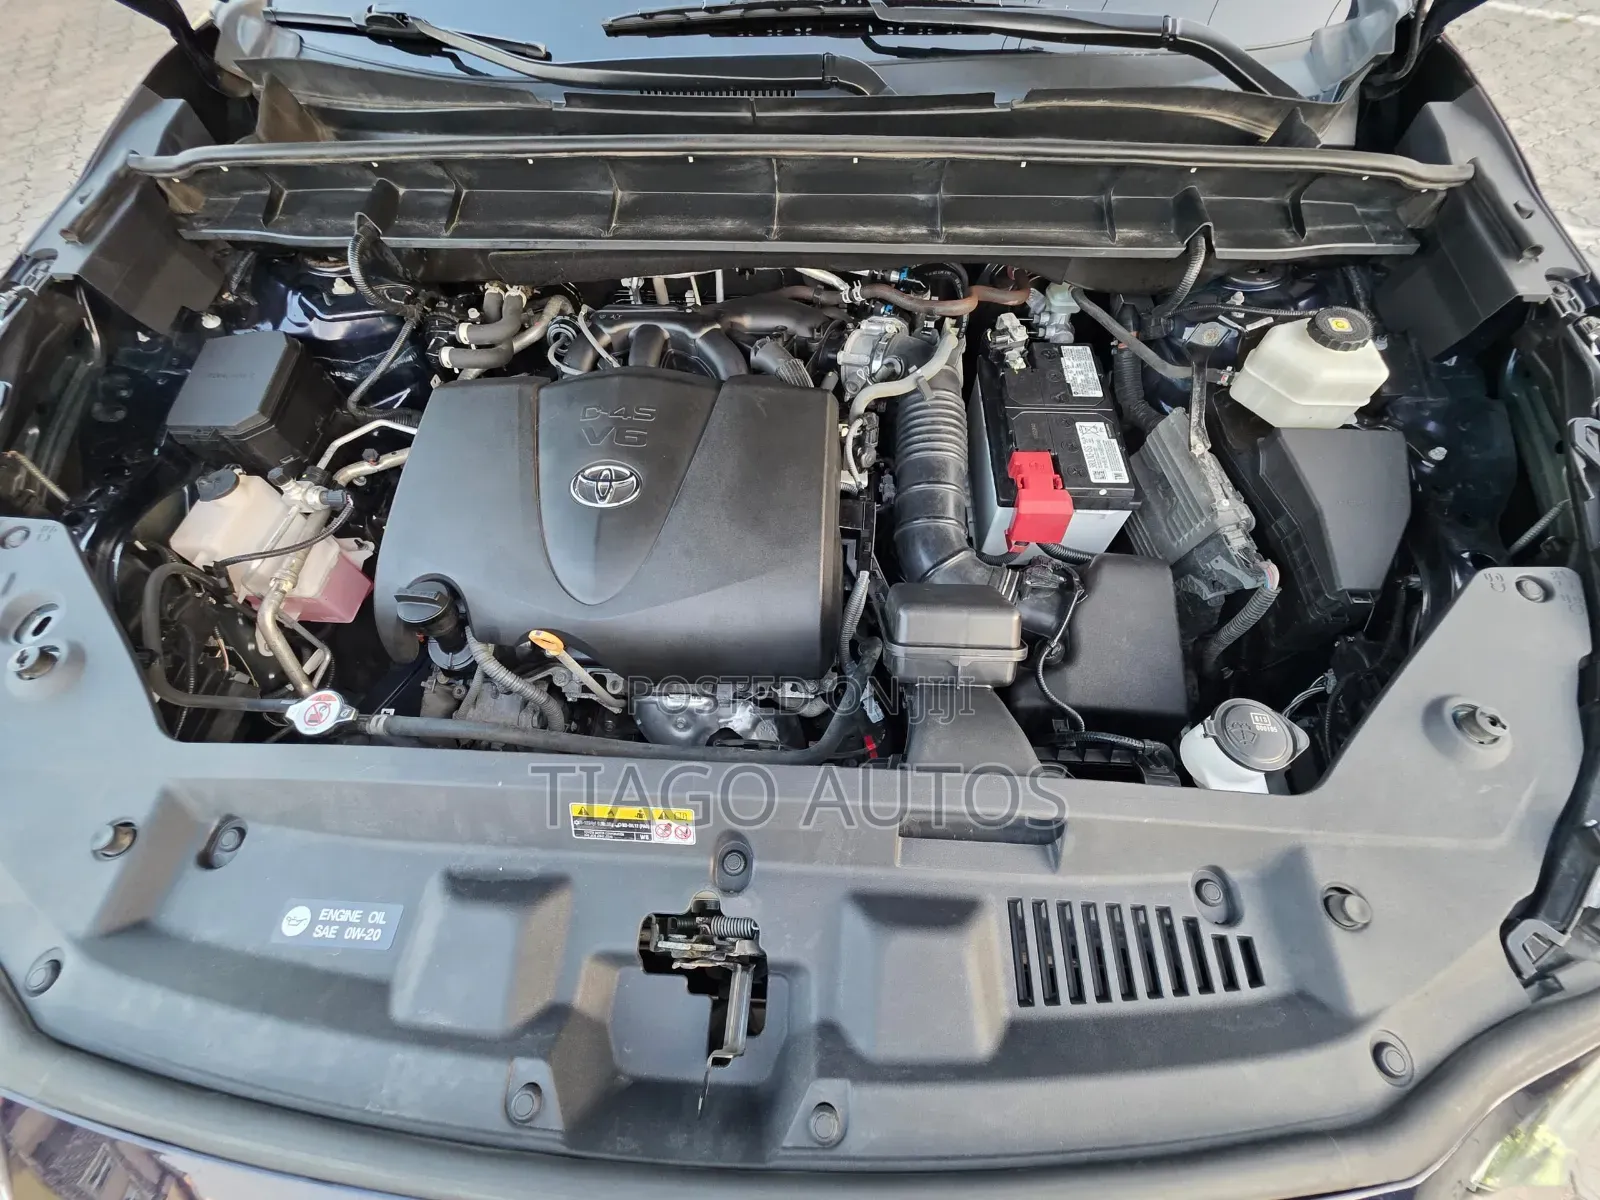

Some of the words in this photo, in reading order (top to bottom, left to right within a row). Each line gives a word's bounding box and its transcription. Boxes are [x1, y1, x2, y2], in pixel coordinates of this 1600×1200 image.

[581, 427, 648, 448] V6
[318, 908, 363, 923] ENGINE
[368, 911, 386, 924] OIL
[312, 924, 339, 939] SAE
[343, 926, 382, 942] 0W-20
